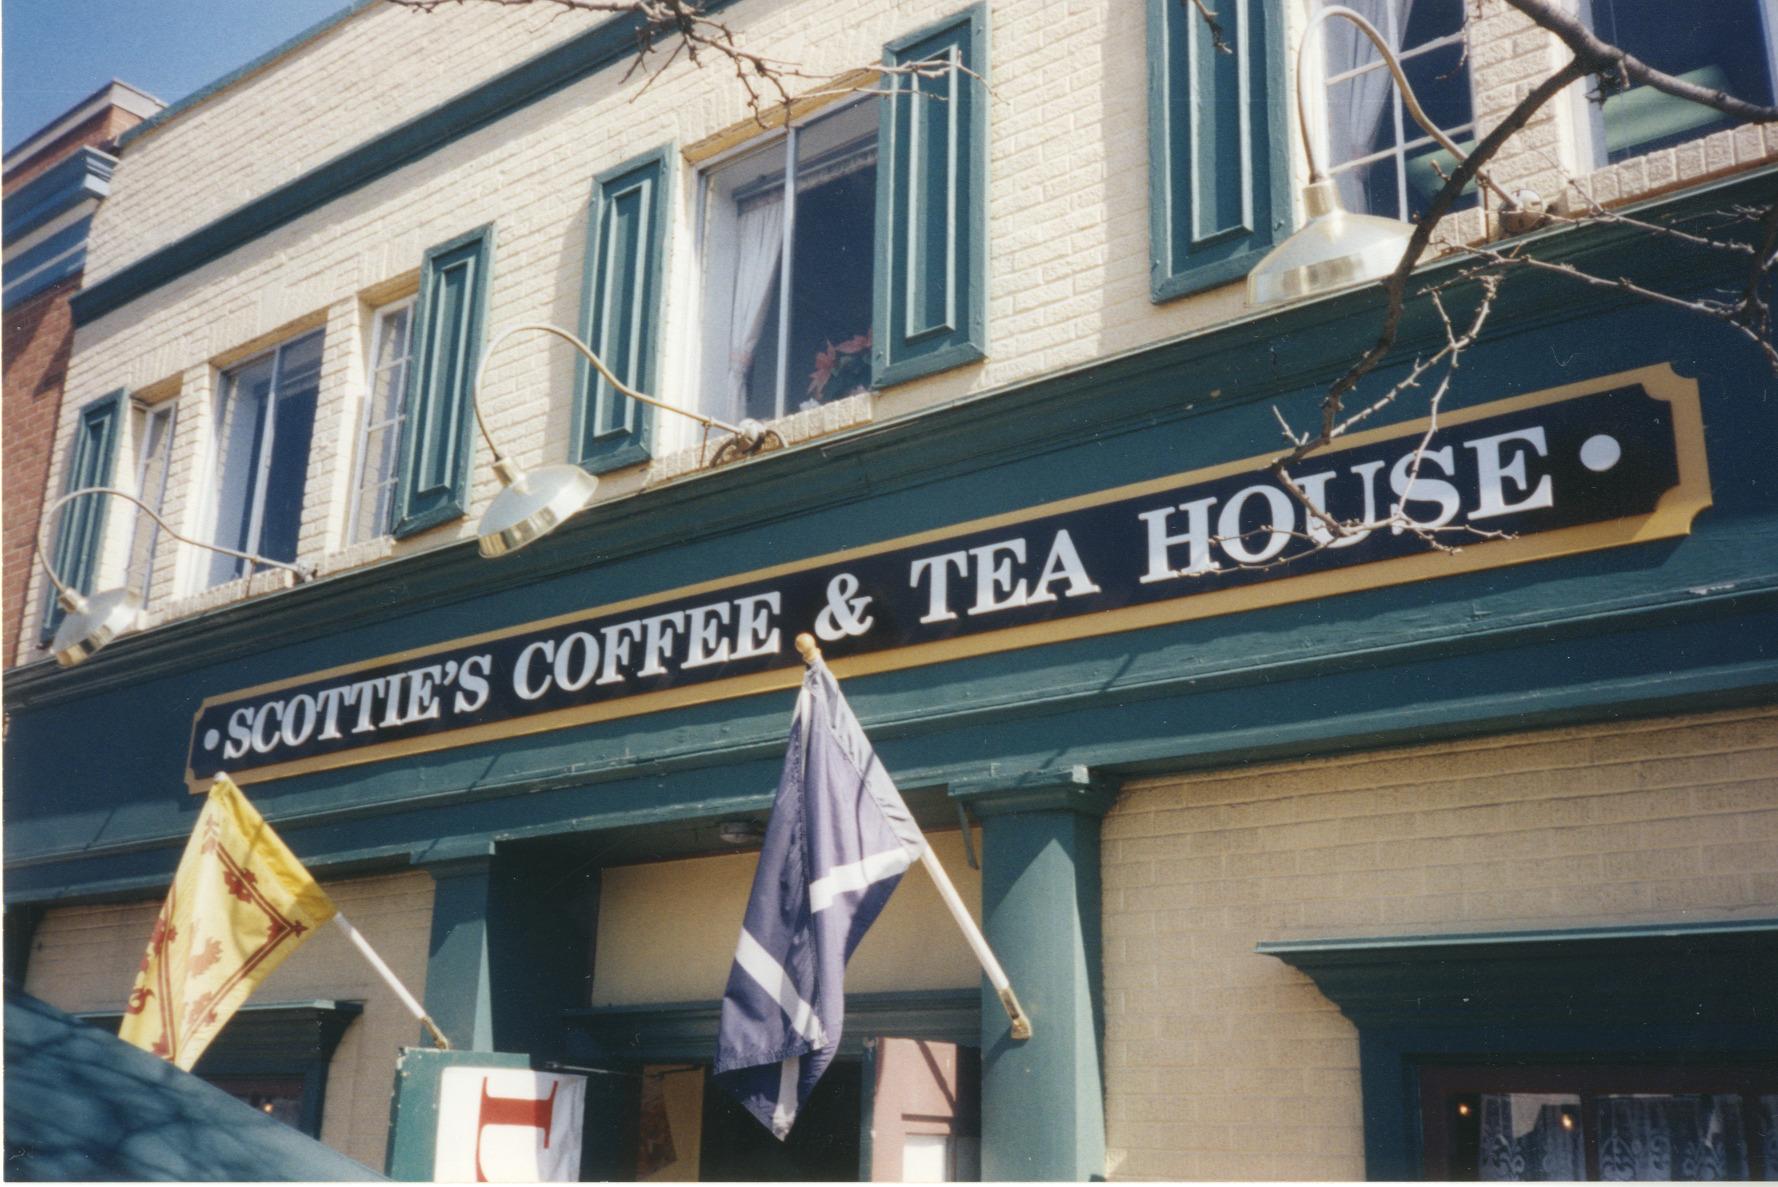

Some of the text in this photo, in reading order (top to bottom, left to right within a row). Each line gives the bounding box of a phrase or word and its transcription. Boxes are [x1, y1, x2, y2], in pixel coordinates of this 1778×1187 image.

[223, 426, 1553, 759] SCOTTIE'S COFFEE & TEA HOUSE
